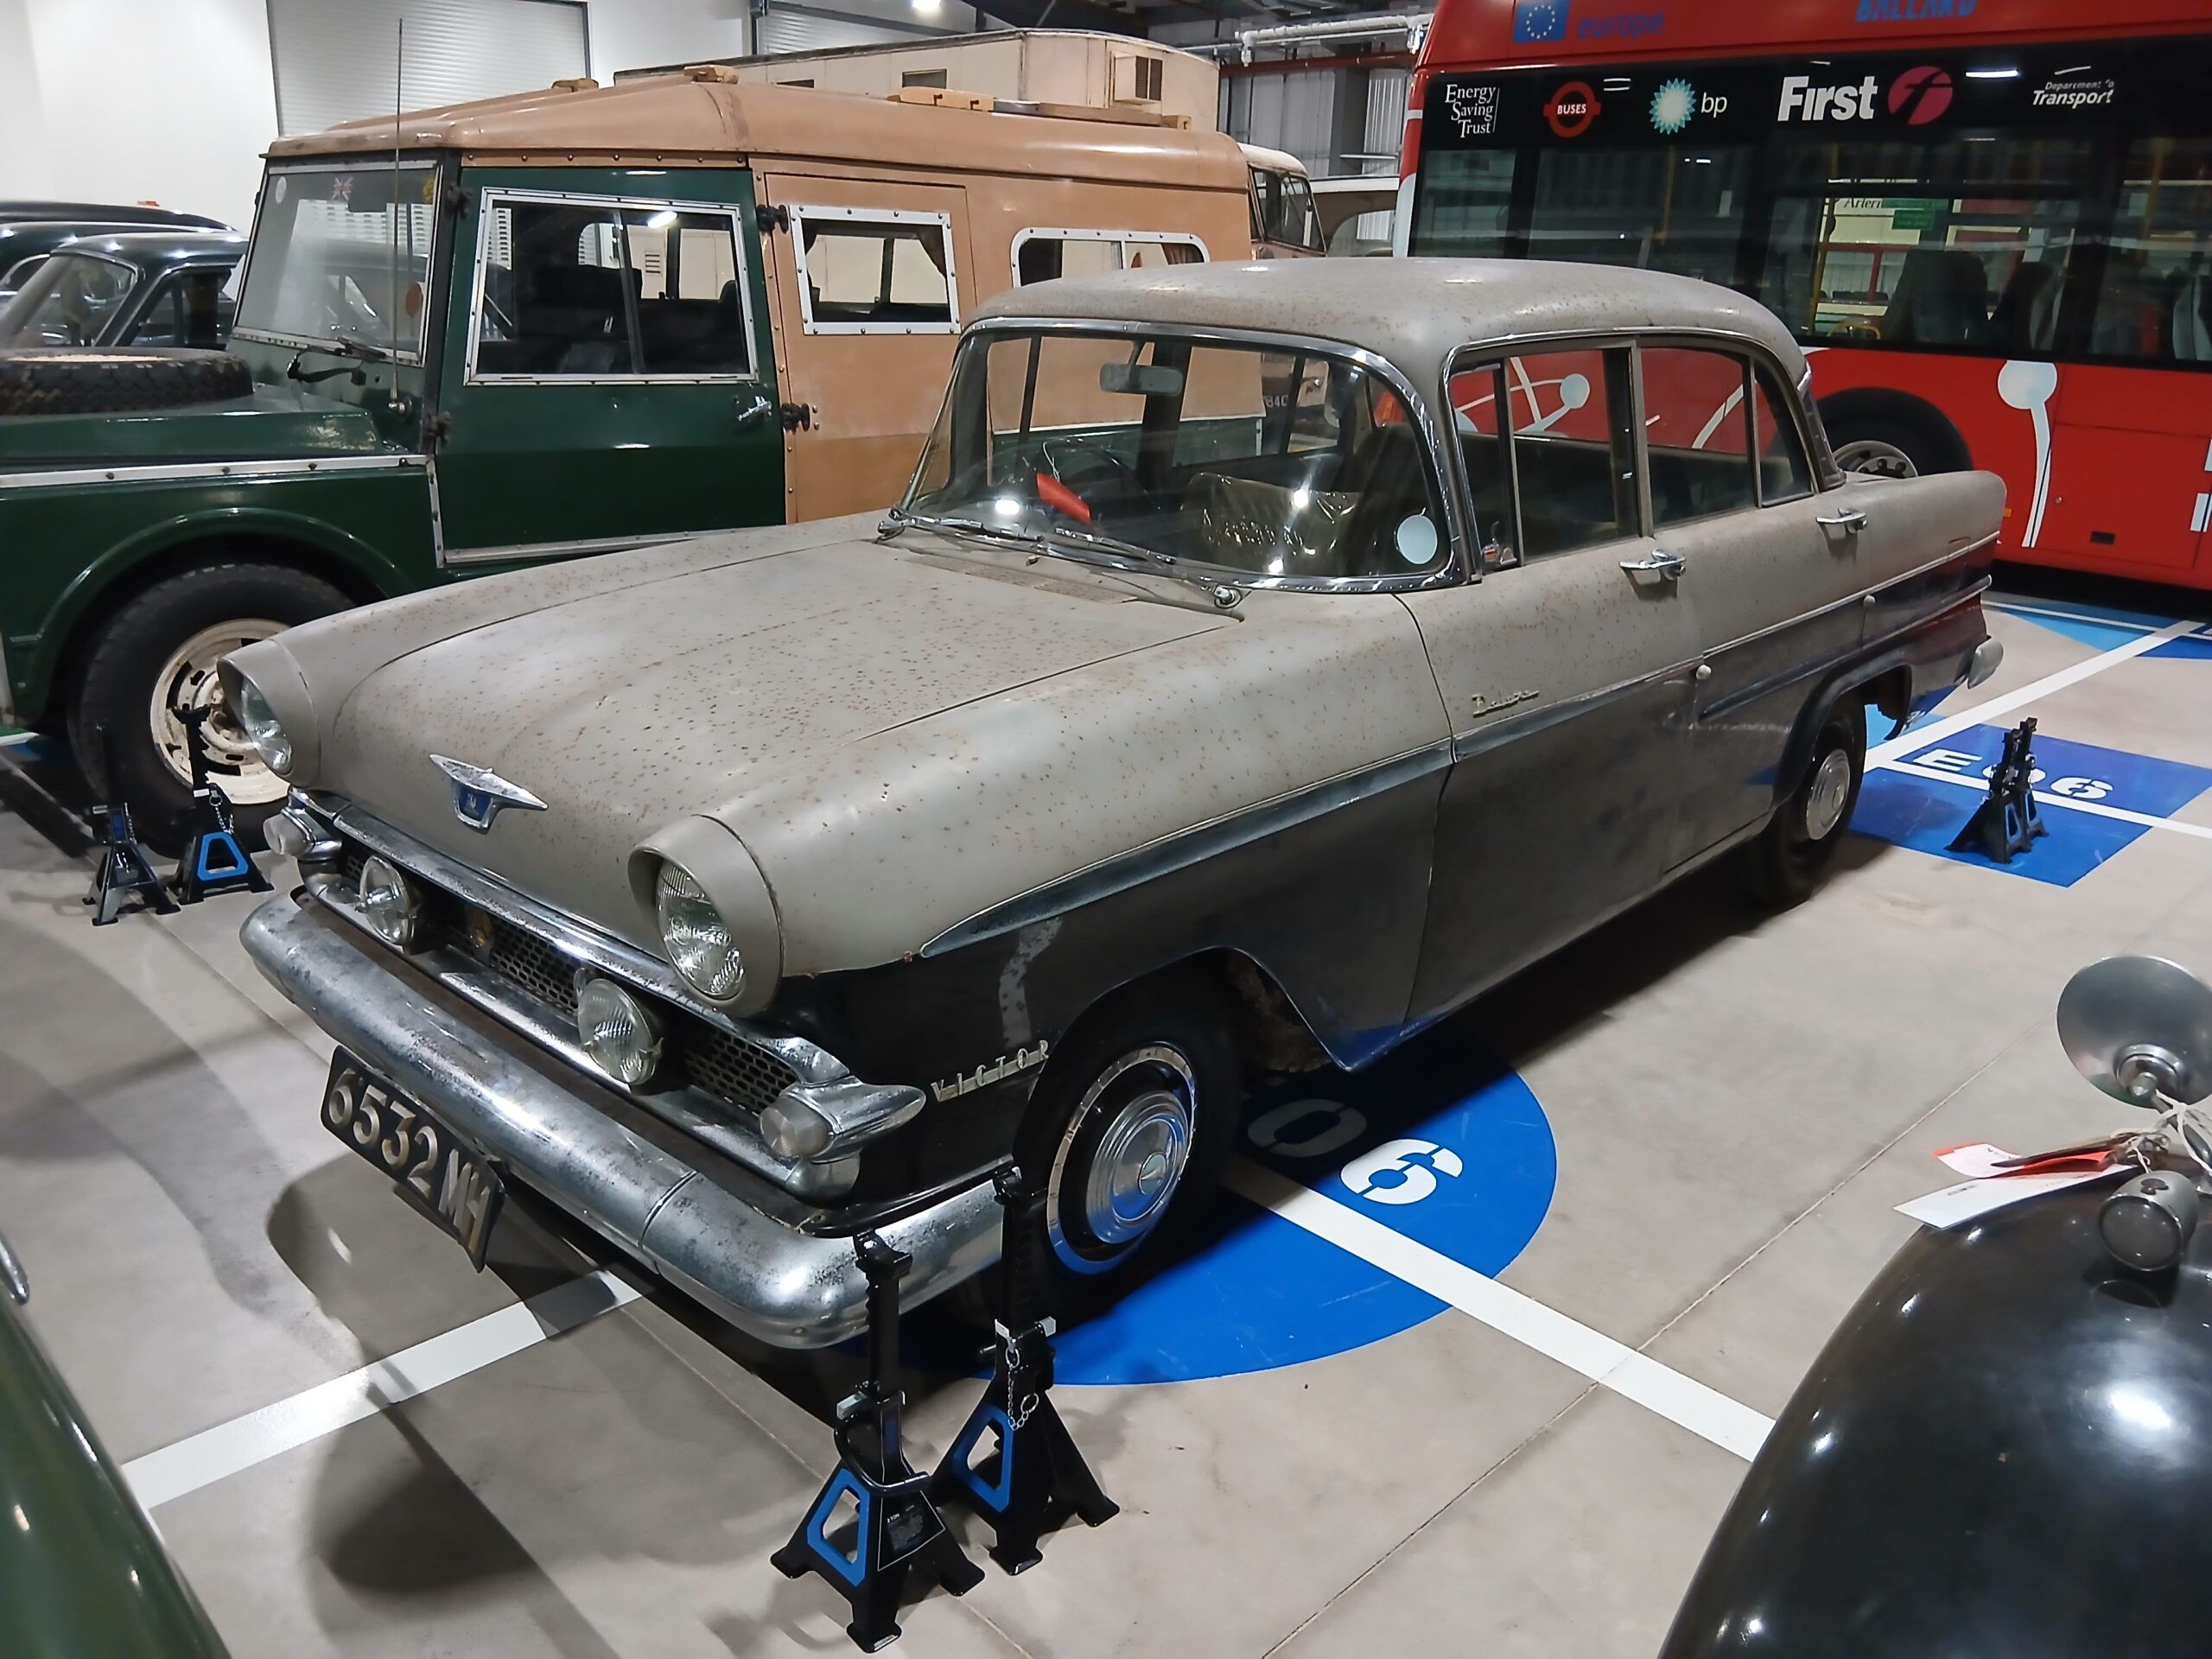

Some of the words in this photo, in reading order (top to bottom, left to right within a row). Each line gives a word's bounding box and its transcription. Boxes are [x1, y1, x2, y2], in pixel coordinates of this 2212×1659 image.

[1578, 12, 1666, 39] europe
[1445, 85, 1497, 103] Energy
[1700, 92, 1727, 118] bp
[1777, 75, 1878, 121] First
[2032, 89, 2114, 109] Transport
[1451, 102, 1493, 120] Saving
[1557, 103, 1587, 115] BUSES
[1458, 119, 1491, 138] Trust
[931, 1039, 1049, 1103] VICTOR
[329, 1067, 438, 1198] 6532
[1243, 1077, 1463, 1205] 06
